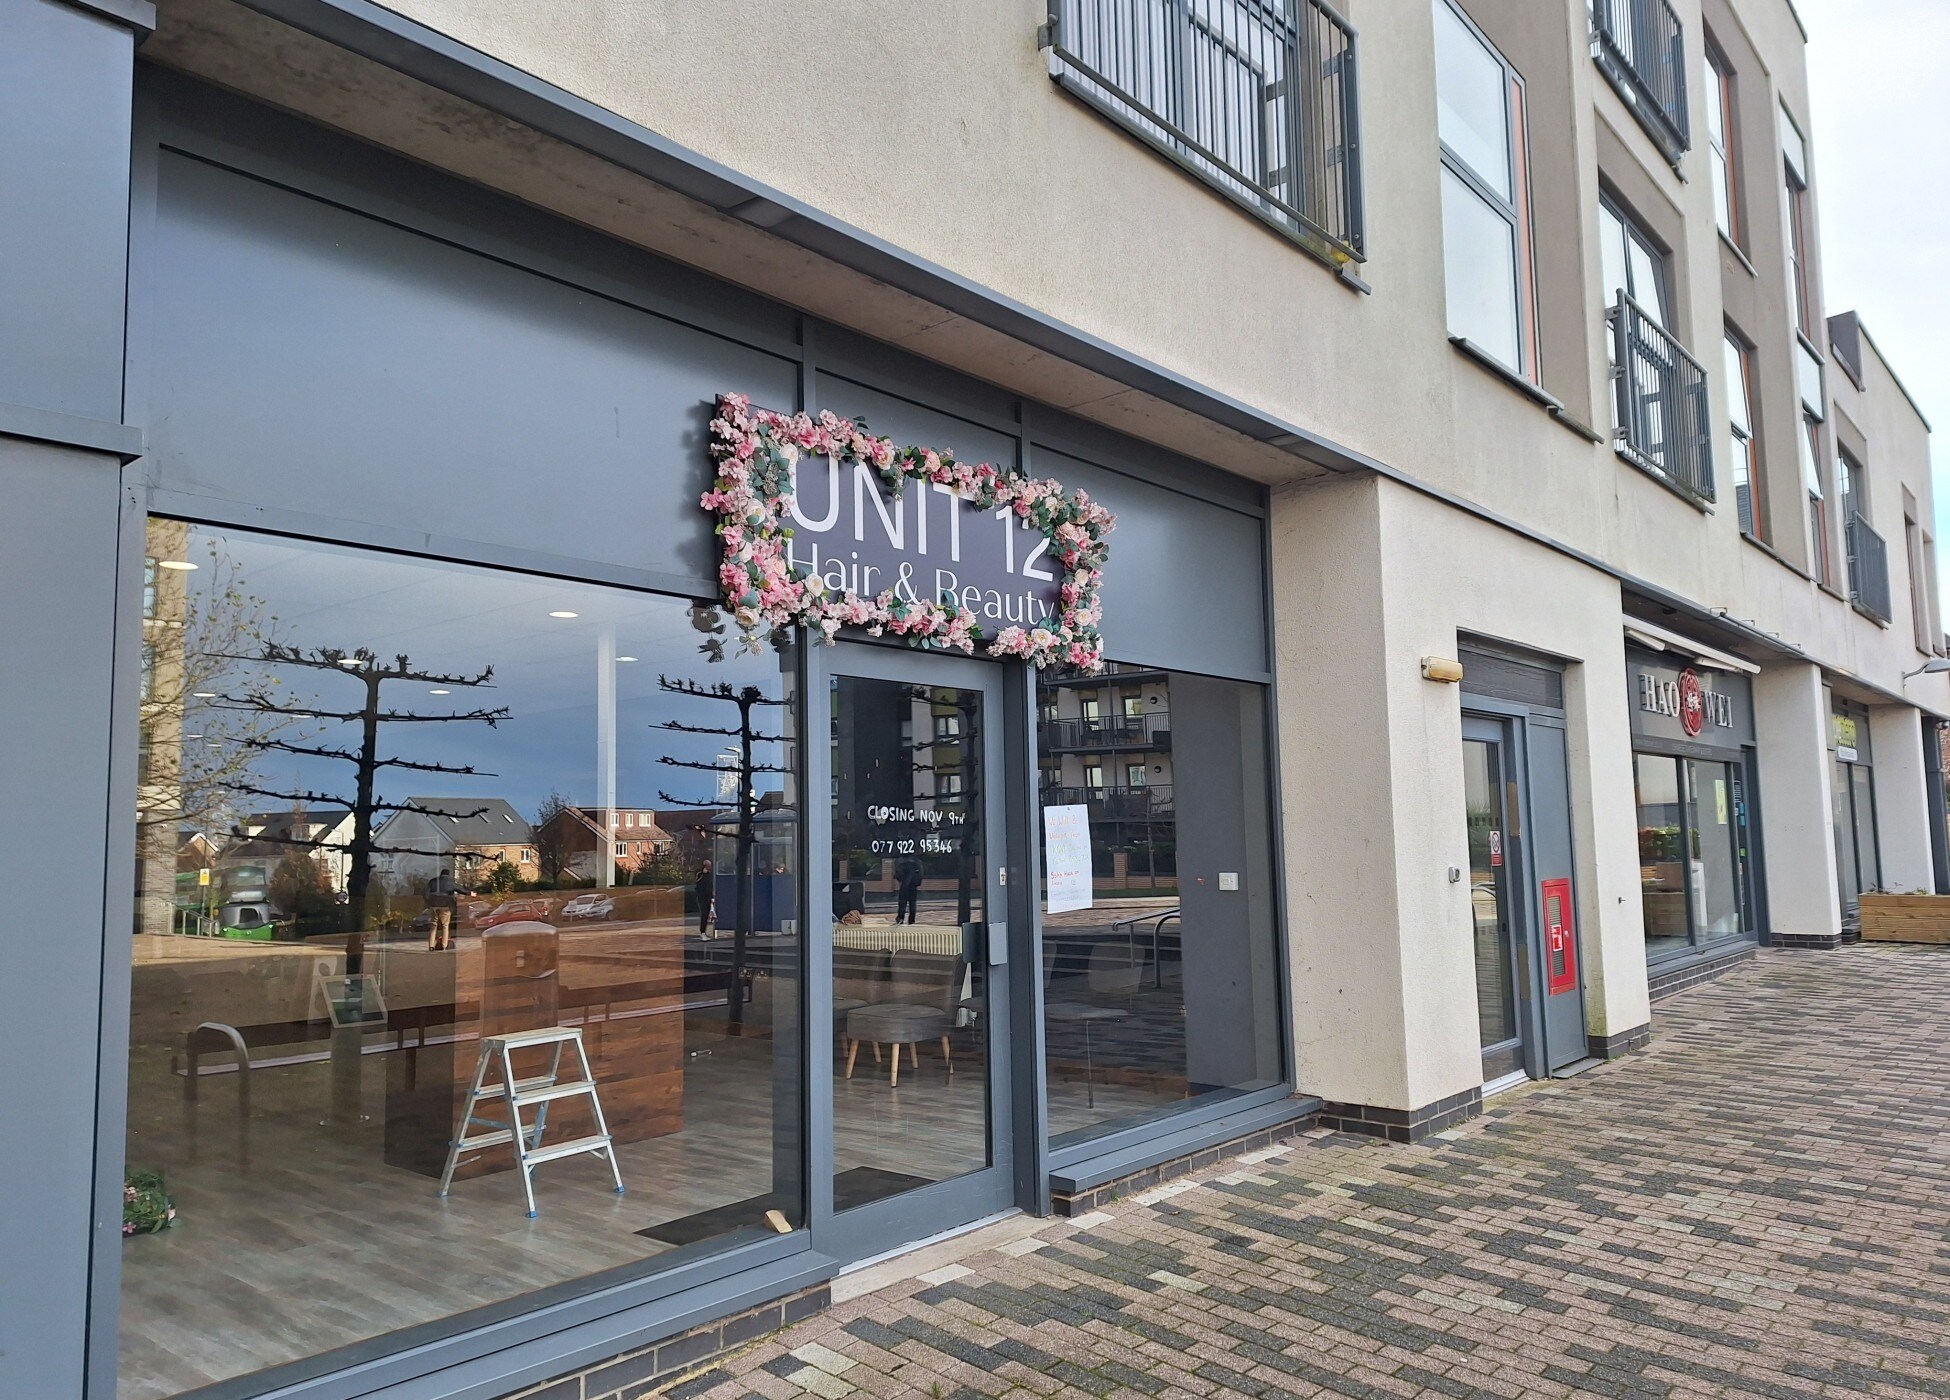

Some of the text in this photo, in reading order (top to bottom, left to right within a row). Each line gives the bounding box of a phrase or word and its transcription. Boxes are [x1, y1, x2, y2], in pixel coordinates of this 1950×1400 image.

[789, 450, 1053, 582] UNIT 12
[787, 537, 1055, 625] Hair & Beauty
[1642, 673, 1681, 718] HAO
[1704, 690, 1733, 728] WEI
[867, 804, 915, 822] CLOSING
[920, 809, 943, 823] NOV
[871, 838, 952, 854] 077 922 95346
